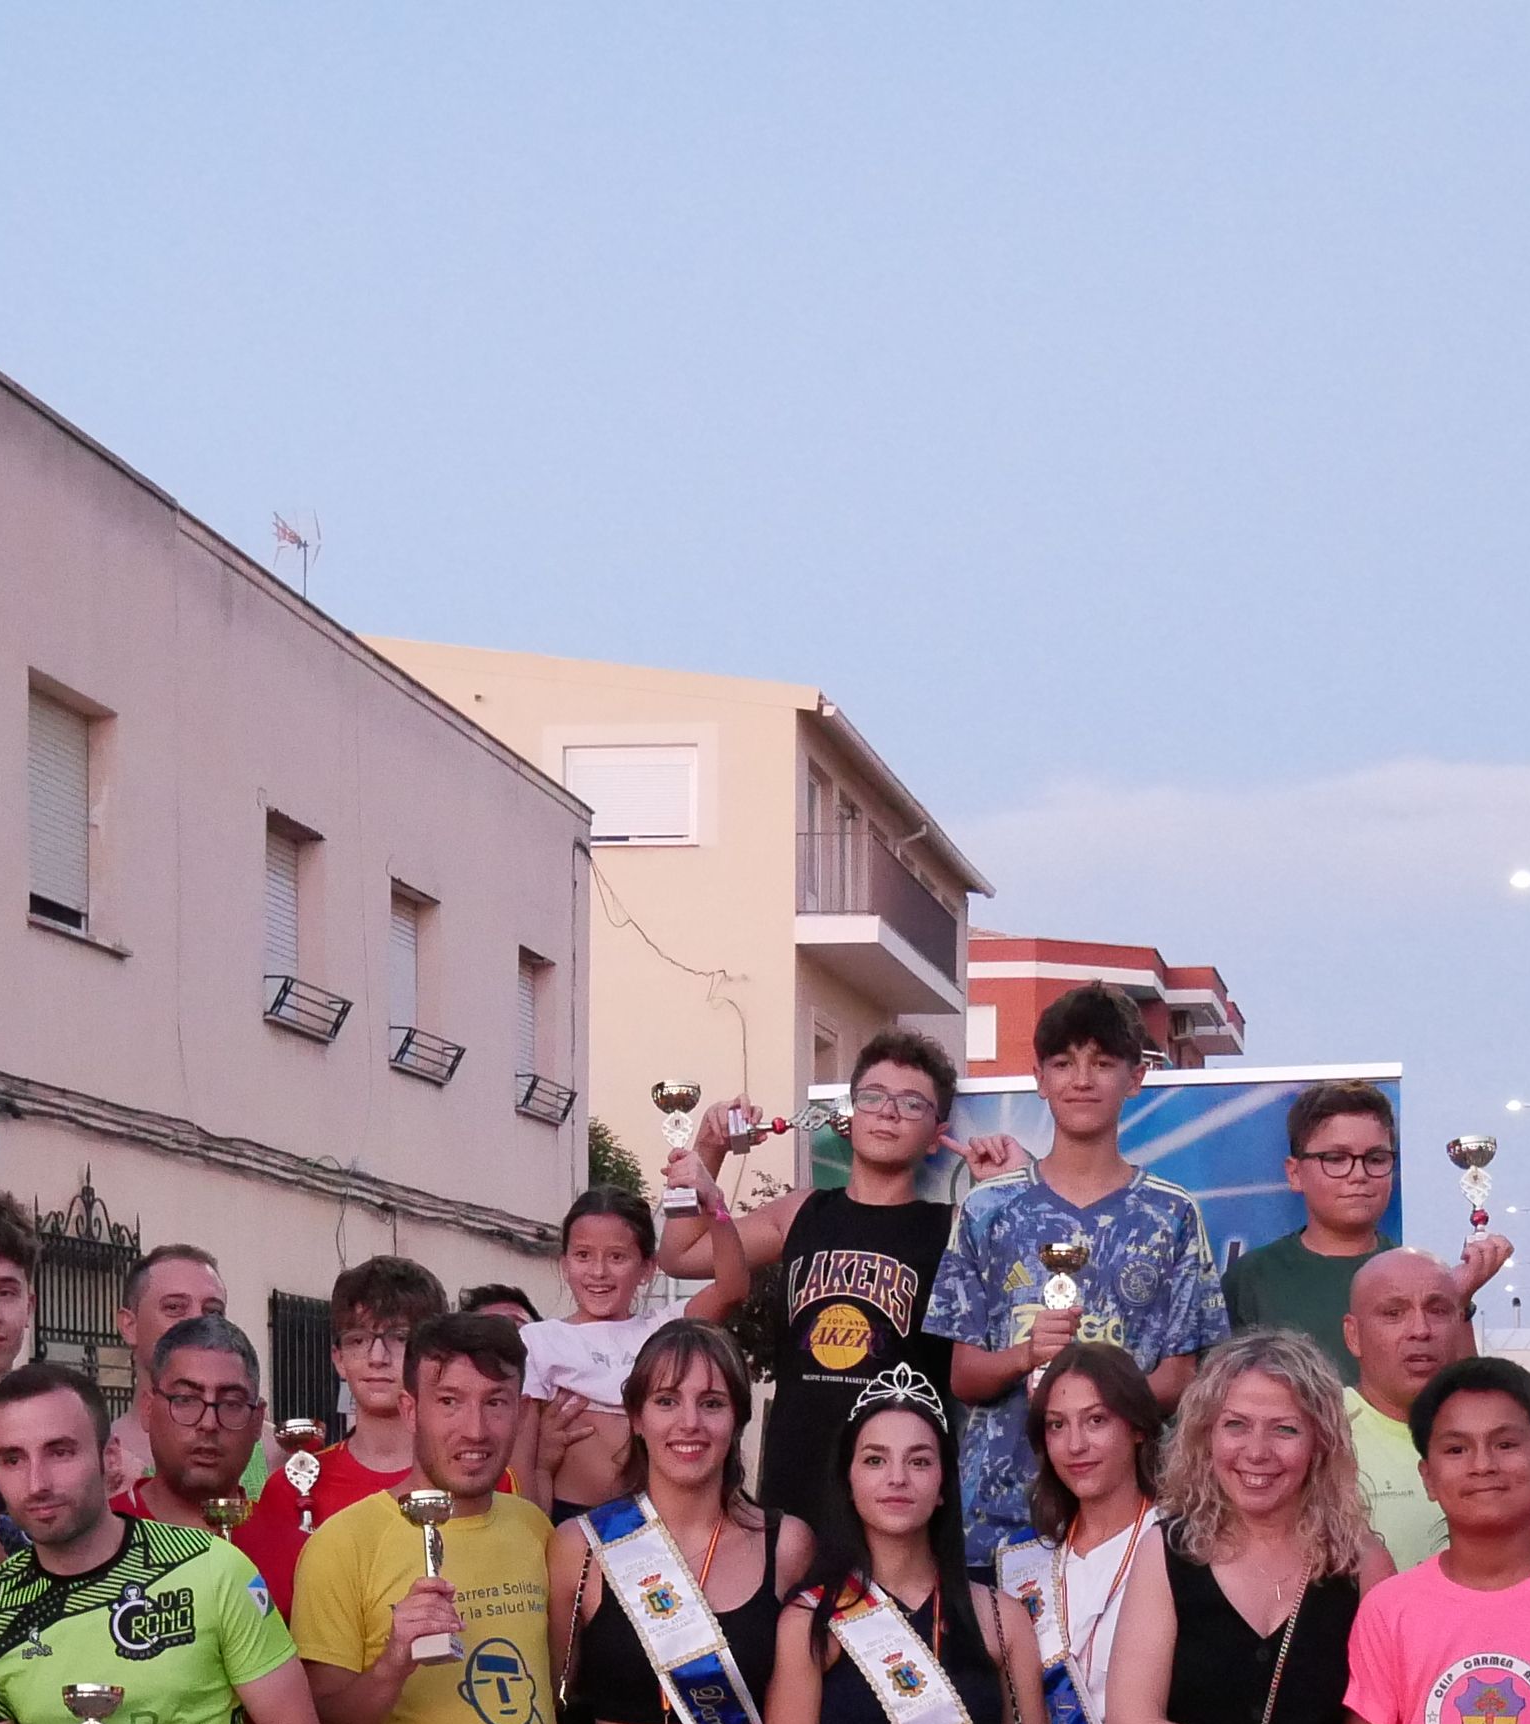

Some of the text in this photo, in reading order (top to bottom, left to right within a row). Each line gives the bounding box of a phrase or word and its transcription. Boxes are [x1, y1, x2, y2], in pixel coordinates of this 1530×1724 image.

[787, 1250, 919, 1339] LAKERS
[457, 1585, 499, 1602] arrera
[470, 1607, 482, 1620] la
[486, 1602, 525, 1617] Salud
[1434, 1673, 1453, 1698] CEIP
[1463, 1656, 1514, 1669] CARMEN
